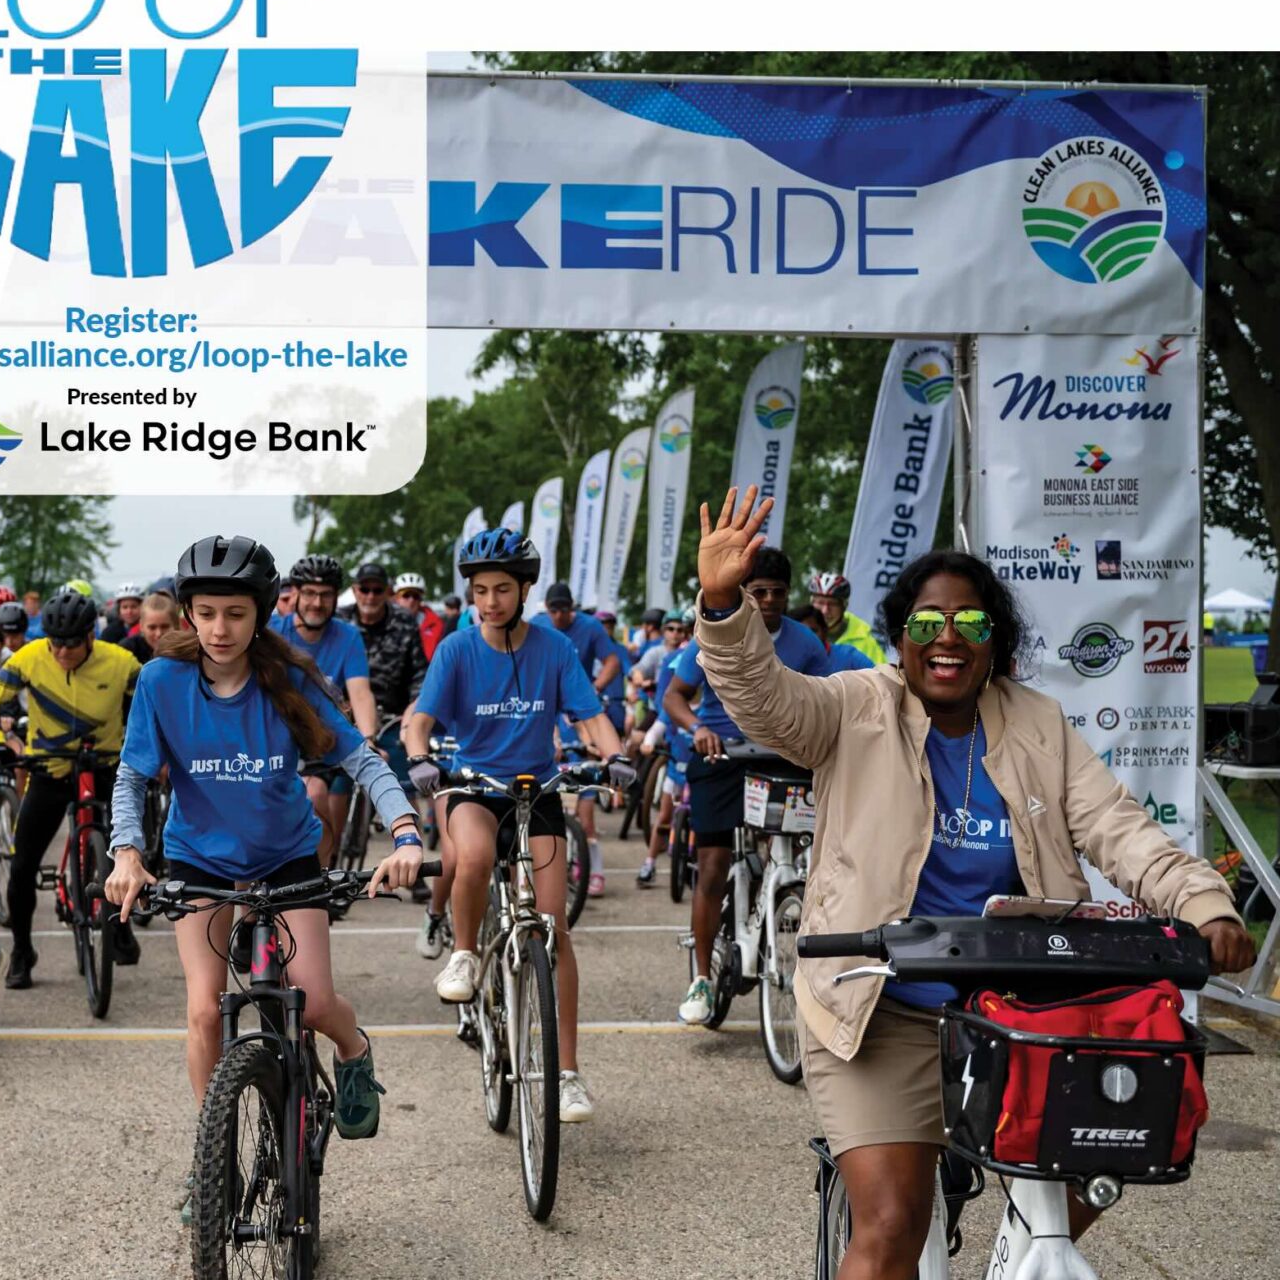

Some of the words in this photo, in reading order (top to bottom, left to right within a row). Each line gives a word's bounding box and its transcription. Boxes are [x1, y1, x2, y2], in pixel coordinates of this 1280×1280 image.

[1023, 157, 1057, 203] CLEAN
[1055, 140, 1105, 163] LAKES
[1108, 146, 1161, 206] ALLIANCE
[1065, 375, 1147, 393] DISCOVER
[993, 372, 1173, 421] Monona
[895, 413, 933, 494] Bank
[1044, 478, 1087, 491] MONONA
[1091, 478, 1116, 491] EAST
[1118, 478, 1139, 491] SIDE
[1044, 493, 1090, 506] BUSINESS
[1093, 493, 1139, 506] ALLIANCE
[660, 487, 677, 557] SCHMIDT
[875, 504, 918, 589] Ridge
[986, 545, 1050, 560] Madison
[1122, 560, 1144, 569] SAN
[1146, 559, 1194, 570] DAMIANO
[997, 561, 1081, 585] akeWay
[1121, 570, 1169, 581] MONONA
[1060, 644, 1110, 658] Madison
[1109, 638, 1134, 653] Top
[1144, 621, 1188, 663] 27
[1173, 649, 1192, 659] abc
[1145, 664, 1186, 673] WKOW
[475, 703, 499, 715] JUST
[1124, 706, 1153, 719] OAK
[1157, 706, 1195, 718] PARK
[1129, 721, 1191, 731] DENTAL
[1116, 746, 1189, 757] SPRINKMAN
[189, 759, 222, 773] JUST
[225, 757, 265, 773] LOOP
[268, 755, 284, 771] IT!
[1116, 758, 1144, 767] REAL
[1148, 757, 1188, 767] ESTATE
[960, 838, 989, 850] Monona
[1070, 1128, 1151, 1140] TREK
